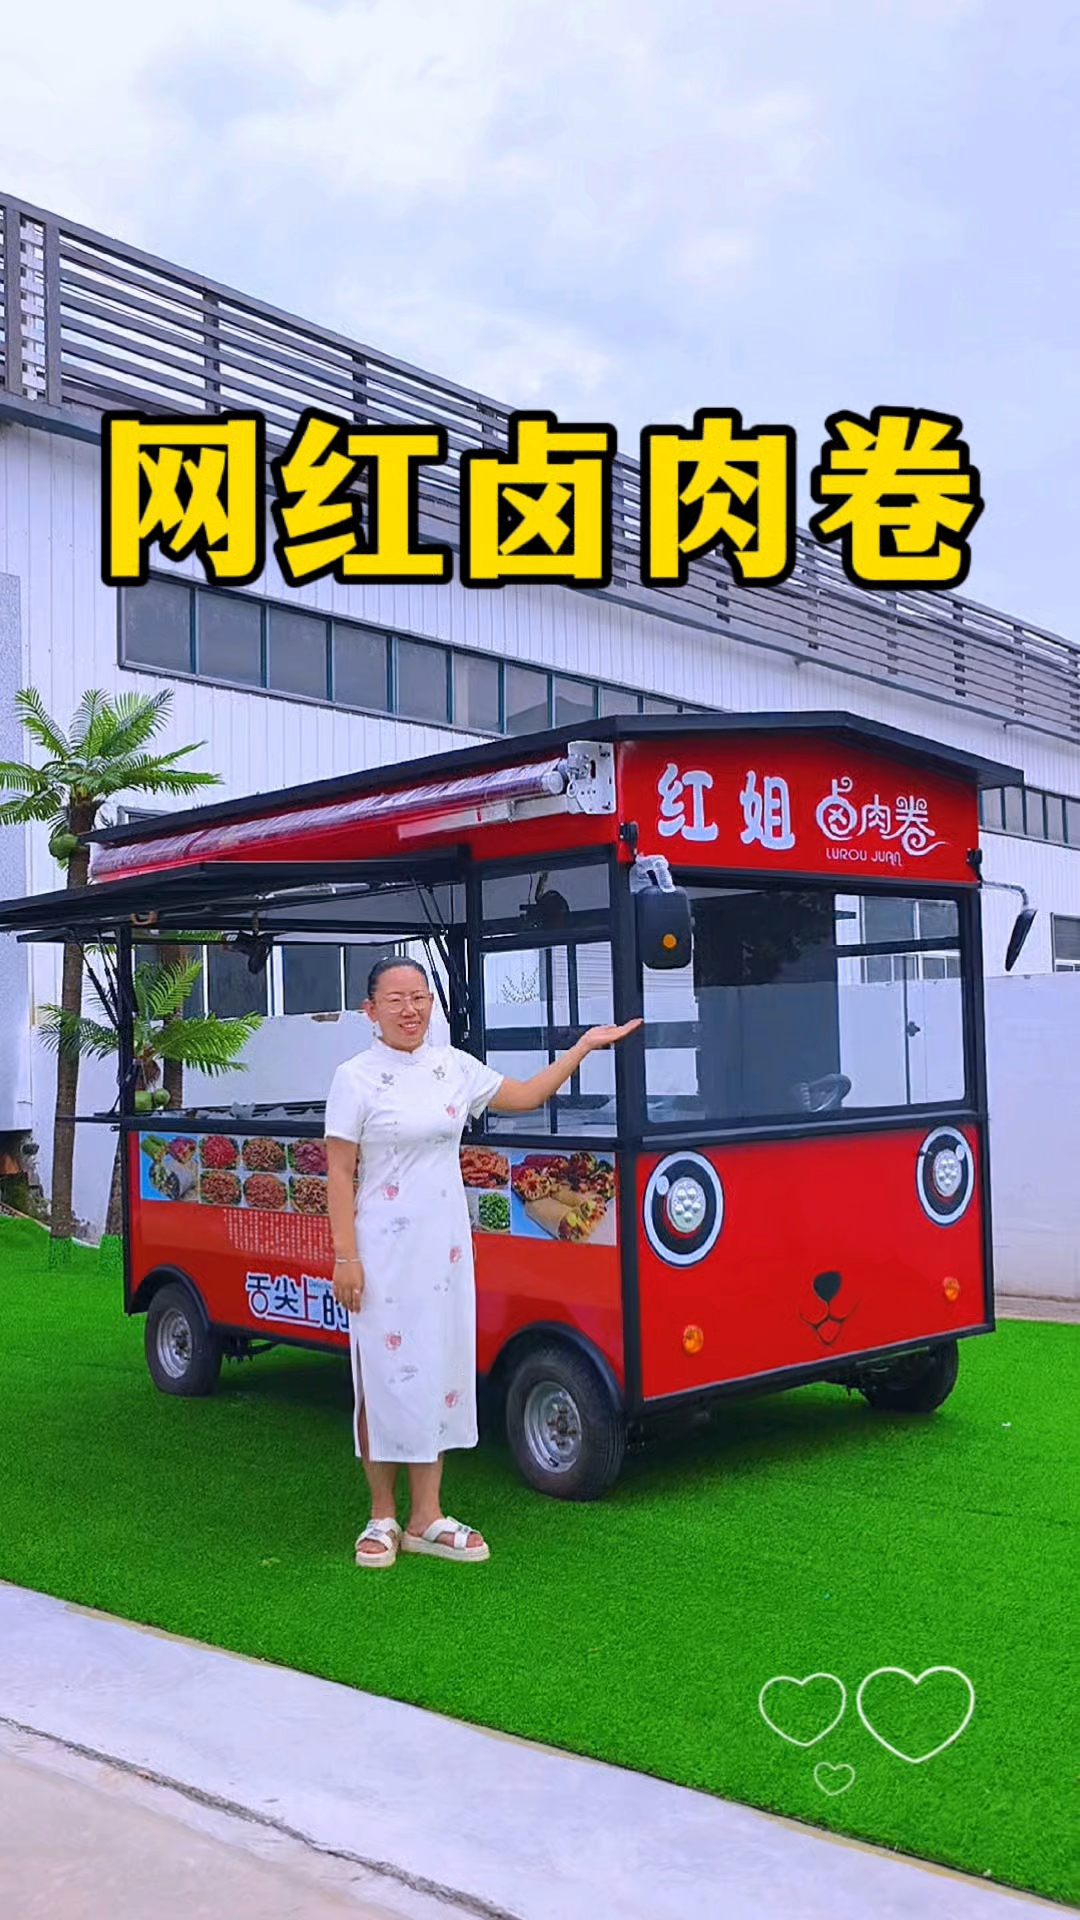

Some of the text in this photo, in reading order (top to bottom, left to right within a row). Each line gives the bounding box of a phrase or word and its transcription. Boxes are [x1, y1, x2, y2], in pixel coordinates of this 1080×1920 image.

[657, 762, 949, 857] 红姐 卤肉卷
[825, 847, 868, 862] LUROU
[246, 1274, 350, 1330] 舌尖上的
